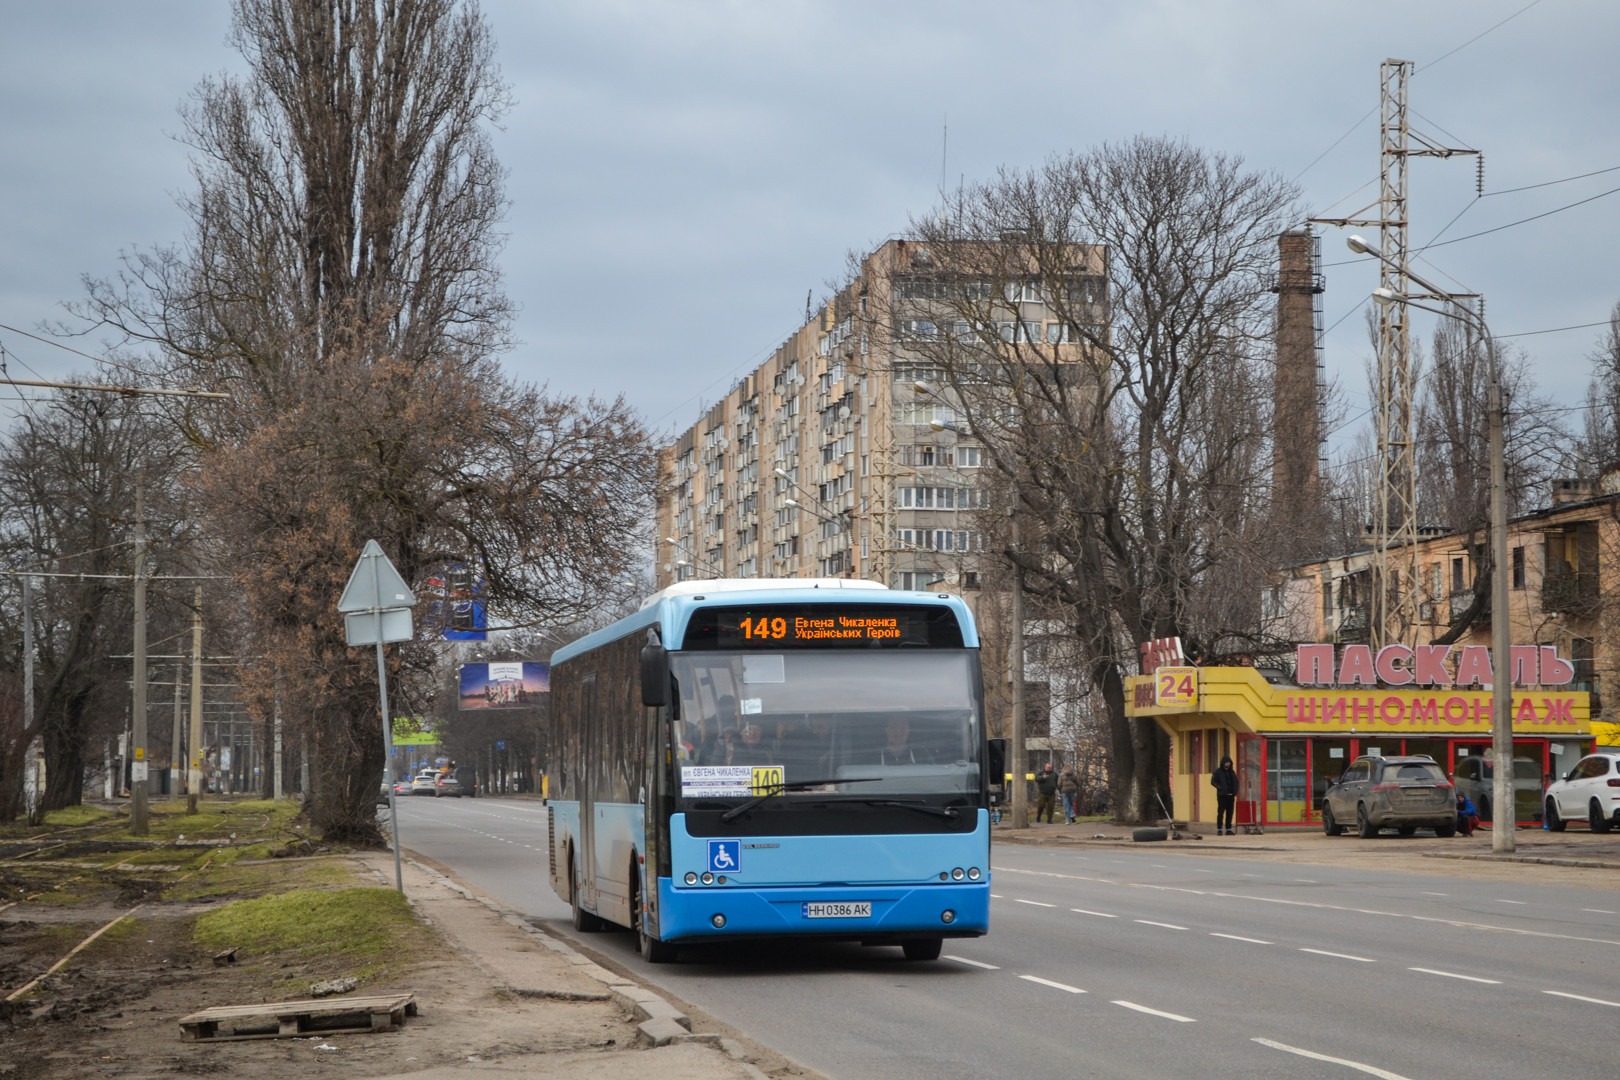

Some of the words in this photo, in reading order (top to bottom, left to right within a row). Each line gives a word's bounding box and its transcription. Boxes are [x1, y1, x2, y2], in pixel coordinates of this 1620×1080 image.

[739, 617, 787, 639] 149
[839, 616, 897, 628] Чикаленка
[795, 628, 862, 640] Українських
[867, 627, 901, 639] Героїв
[1297, 643, 1574, 685] ПАСКАЛЬ
[1160, 675, 1194, 698] 24
[1287, 696, 1577, 724] ШИНОМОНАЖ
[754, 769, 780, 796] 149
[826, 905, 851, 915] 0386
